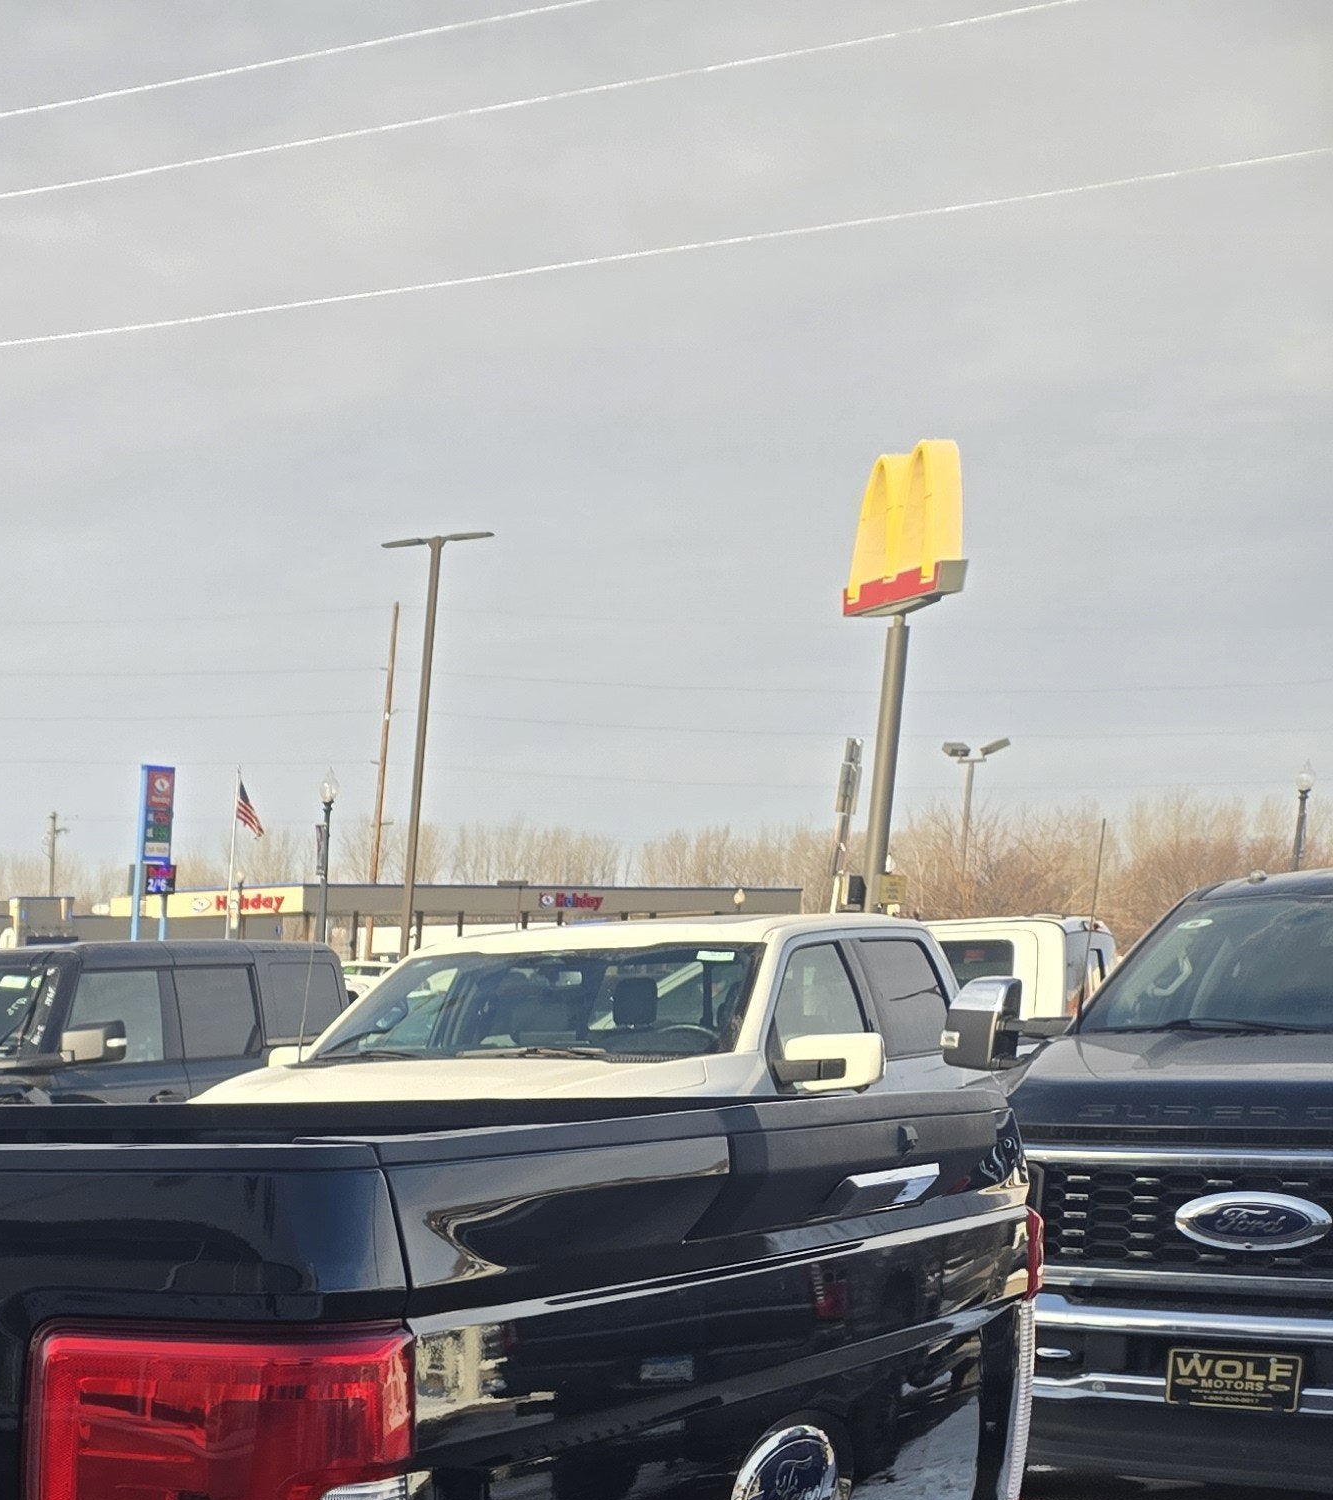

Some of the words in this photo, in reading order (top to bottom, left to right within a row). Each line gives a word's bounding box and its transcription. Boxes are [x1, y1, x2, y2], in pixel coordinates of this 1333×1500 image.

[1077, 1103, 1288, 1121] SUPER
[1214, 1206, 1287, 1233] Ford
[1175, 1357, 1293, 1382] WOLF
[1200, 1378, 1265, 1391] MOTORS
